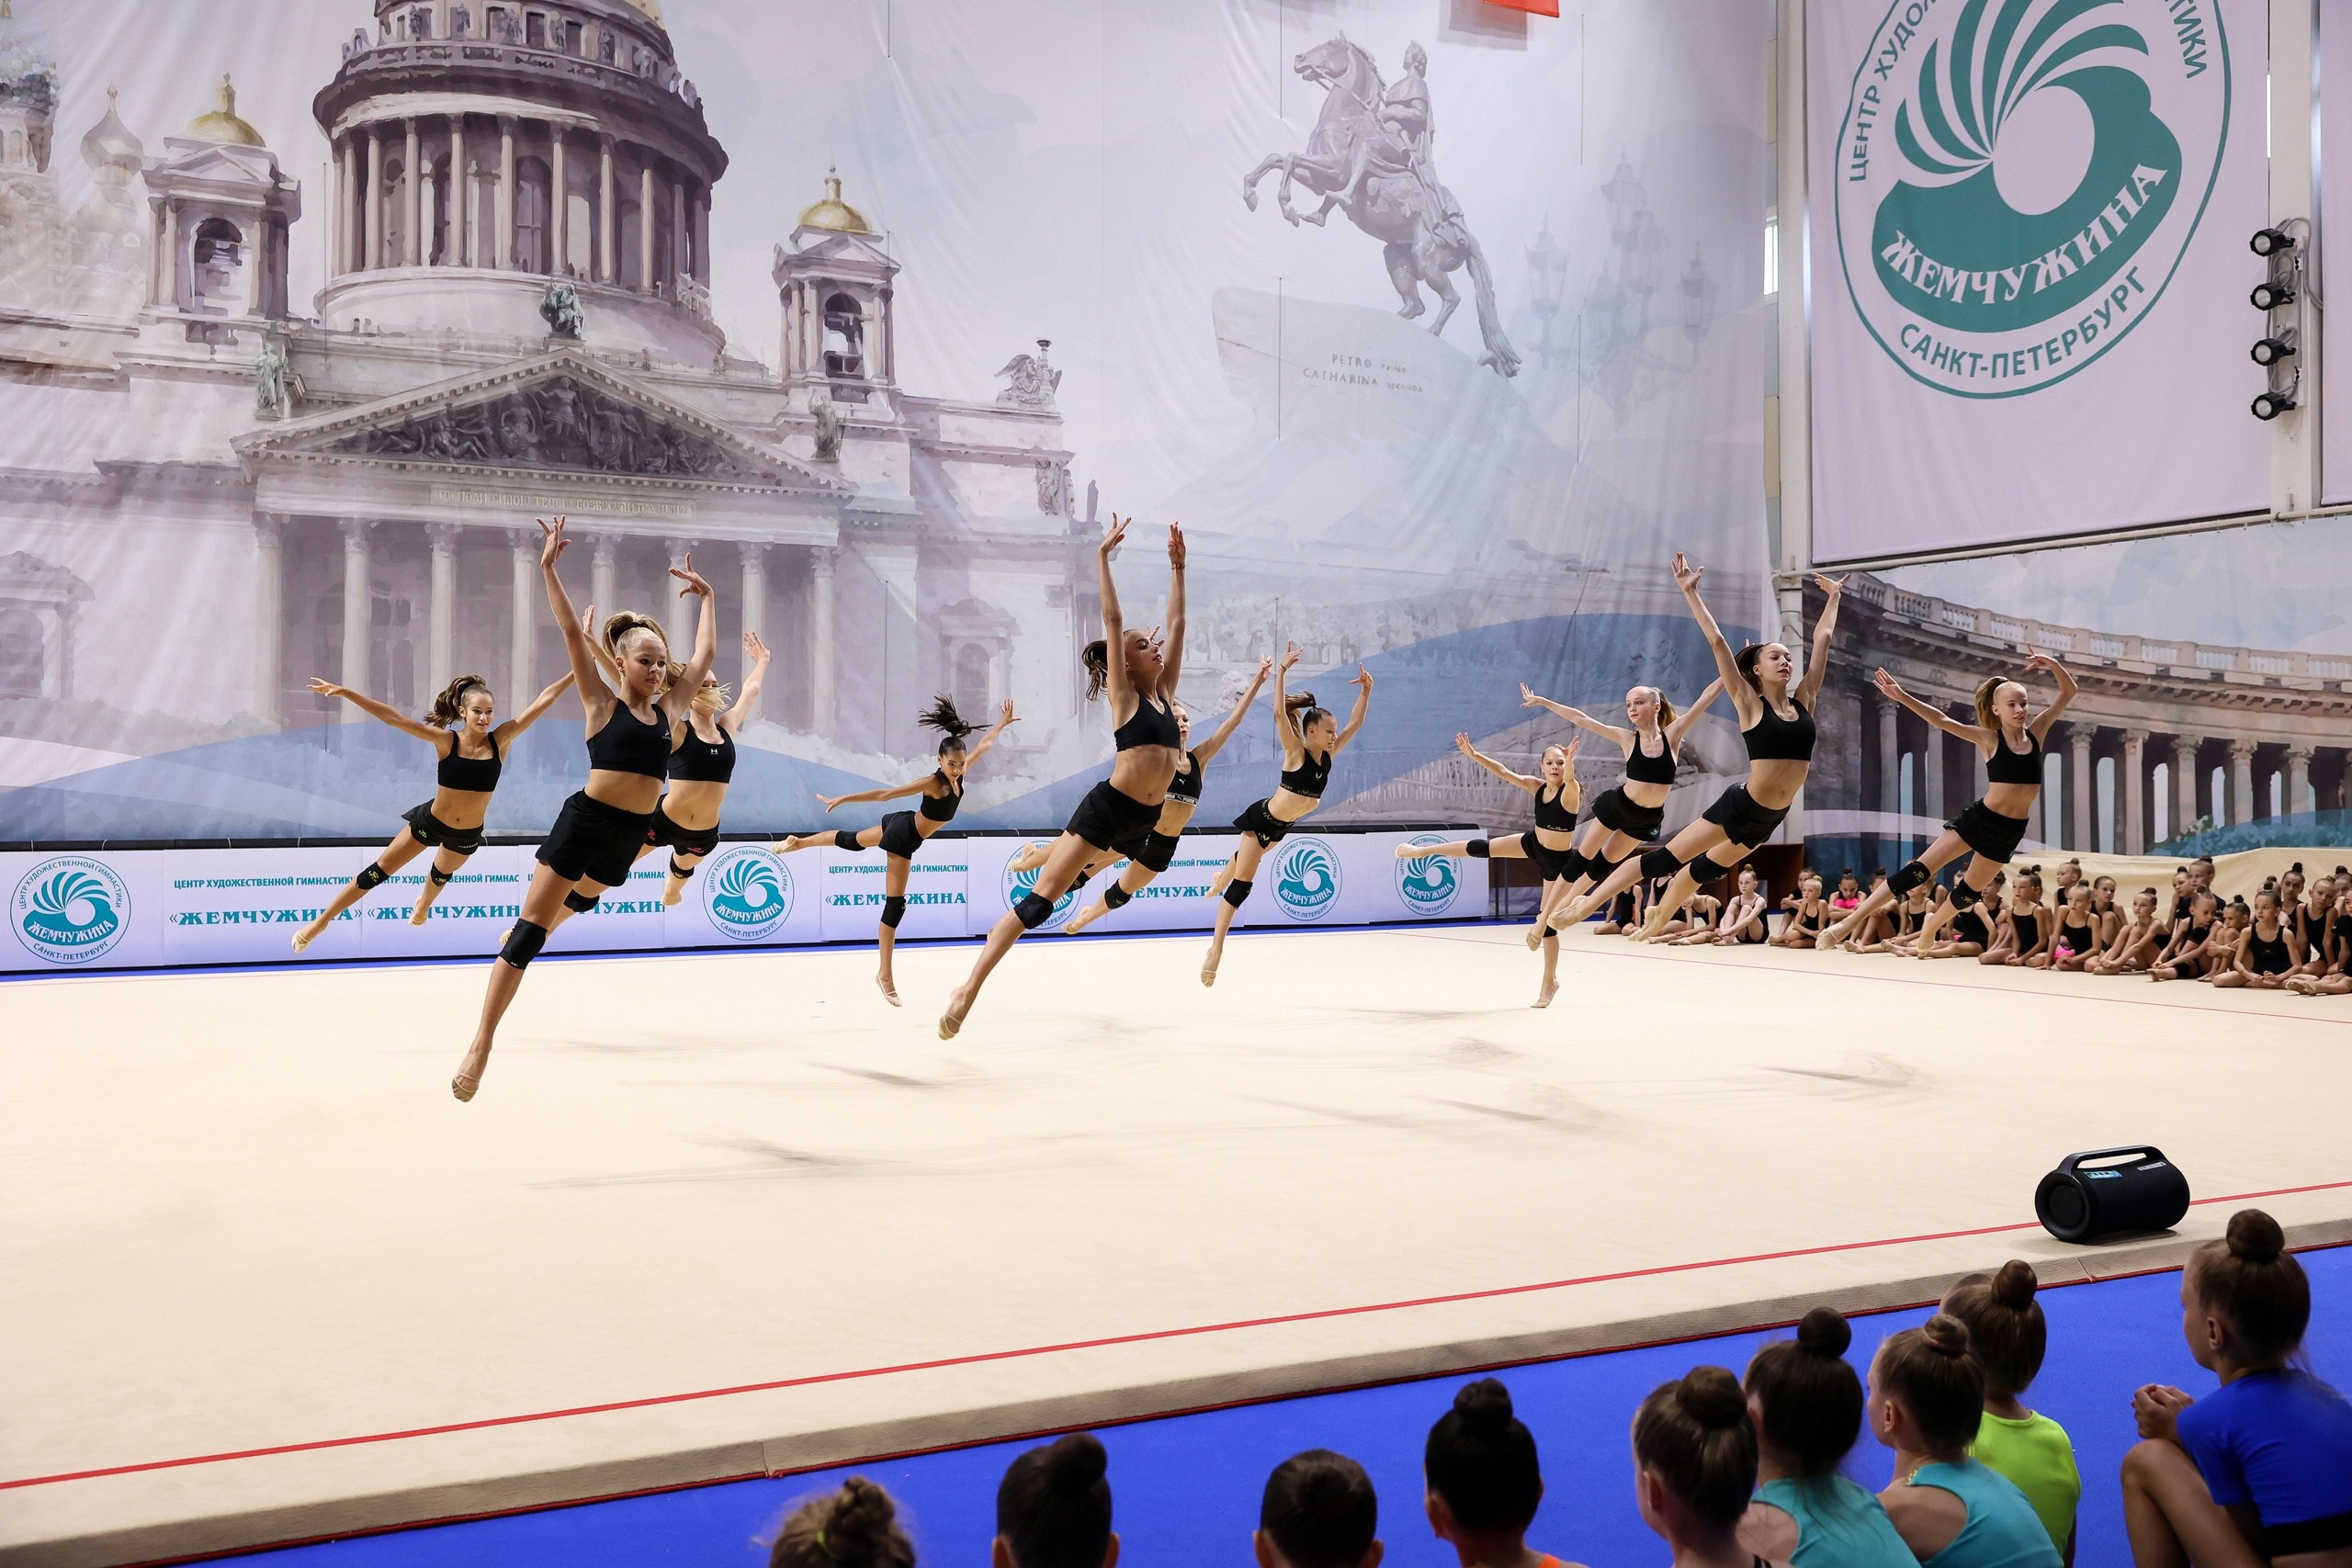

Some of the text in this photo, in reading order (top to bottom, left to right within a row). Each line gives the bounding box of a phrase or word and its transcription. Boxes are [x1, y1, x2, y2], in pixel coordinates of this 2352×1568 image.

[1849, 85, 1881, 182] ЦЕНТР
[1881, 163, 2167, 305] ЖЕМЧУЖИНА
[1900, 265, 2145, 378] САНКТ-ПЕТЕРБУРГ
[1331, 354, 1372, 368] PETRO
[1303, 367, 1378, 386] CATHARINA
[829, 865, 853, 874] ЦЕНТР
[1114, 861, 1131, 869] ЦЕНТ
[19, 860, 123, 909] ЦЕНТР ХУДОЖЕСТВЕННОЙ ГИМНАСТИКИ
[174, 879, 205, 889] ЦЕНТР
[206, 876, 294, 888] ХУДОЖЕСТВЕННОЙ
[169, 908, 362, 926] «ЖЕМЧУЖИА»
[716, 902, 782, 922] ЖЕМЧУЖИНА
[27, 919, 115, 942] ЖЕМЧУЖИНА
[33, 940, 109, 960] САНКТ-ПЕТЕРБУРГ
